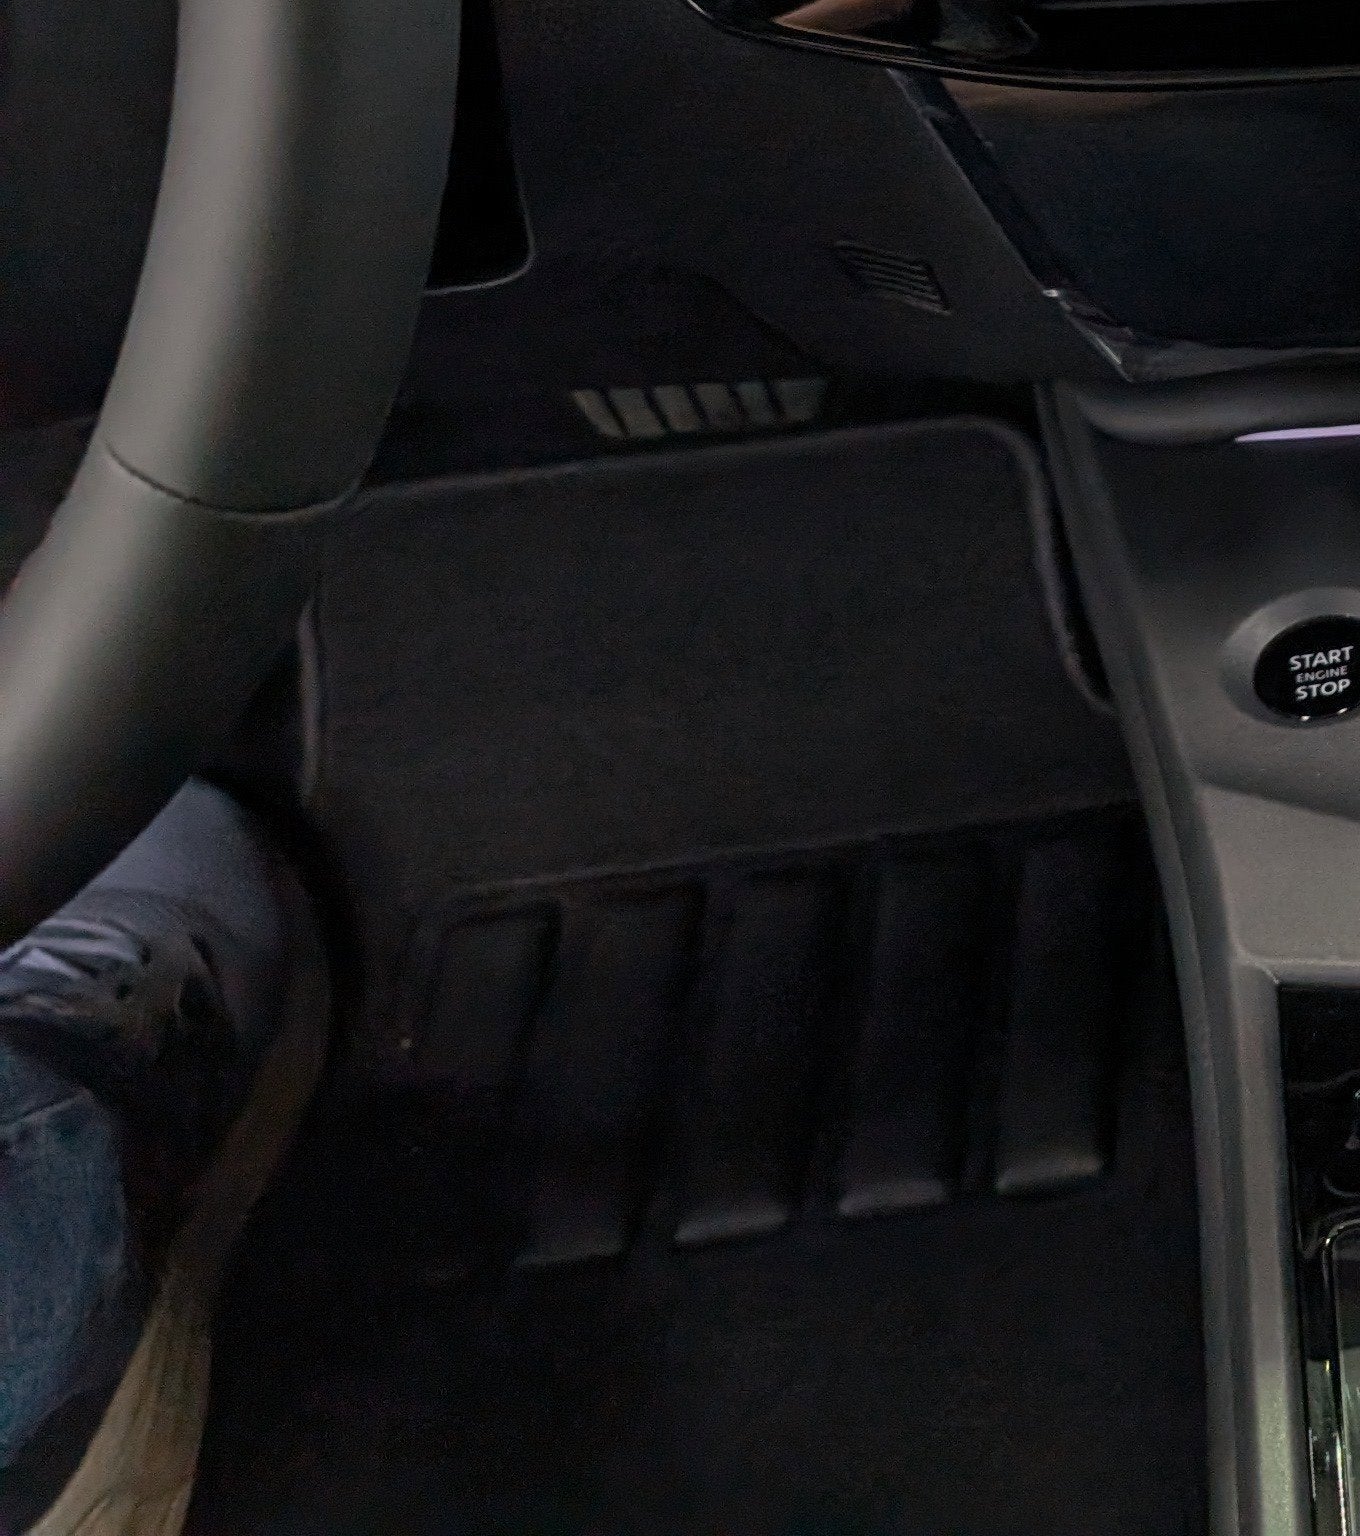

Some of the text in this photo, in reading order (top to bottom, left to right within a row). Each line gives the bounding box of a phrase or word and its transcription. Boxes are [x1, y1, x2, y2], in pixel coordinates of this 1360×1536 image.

[1289, 645, 1354, 671] START
[1296, 665, 1348, 683] ENGINE
[1295, 678, 1350, 701] STOP
